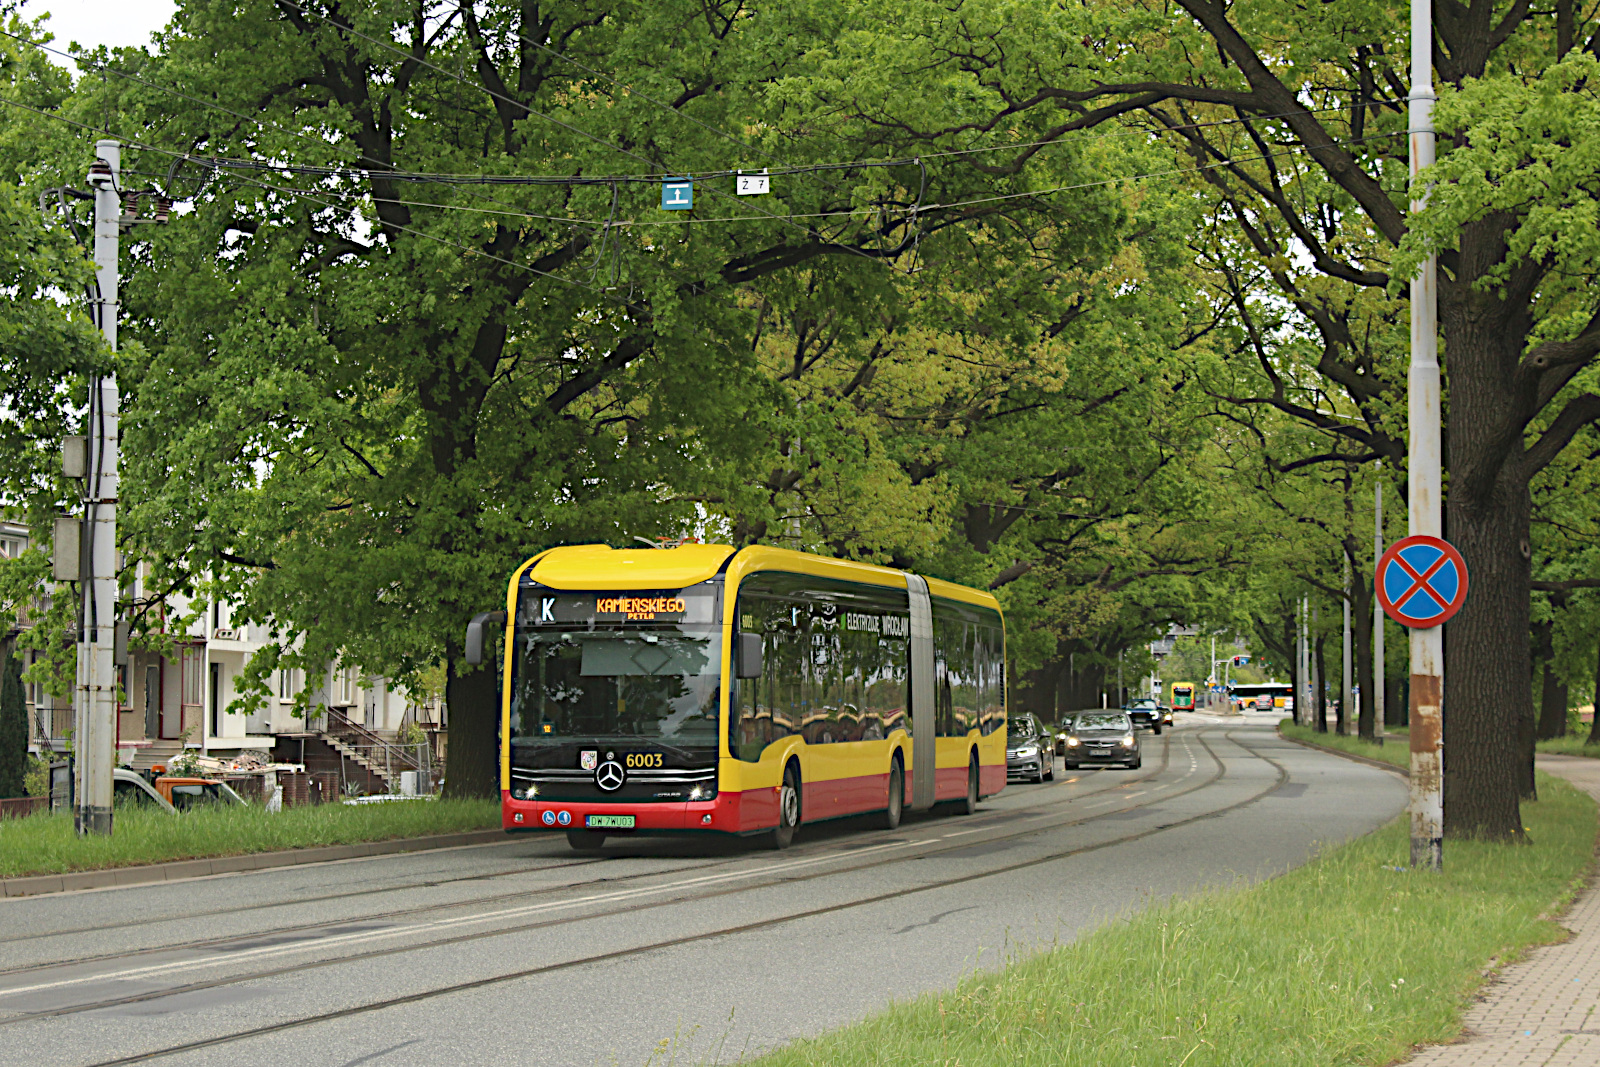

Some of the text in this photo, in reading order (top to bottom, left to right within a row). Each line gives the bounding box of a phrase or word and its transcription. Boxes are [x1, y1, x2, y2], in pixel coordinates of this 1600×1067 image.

[541, 597, 555, 622] K
[596, 597, 686, 613] KAMIEŃSKIEGO
[627, 612, 655, 620] PĘTLA
[626, 753, 663, 768] 6003
